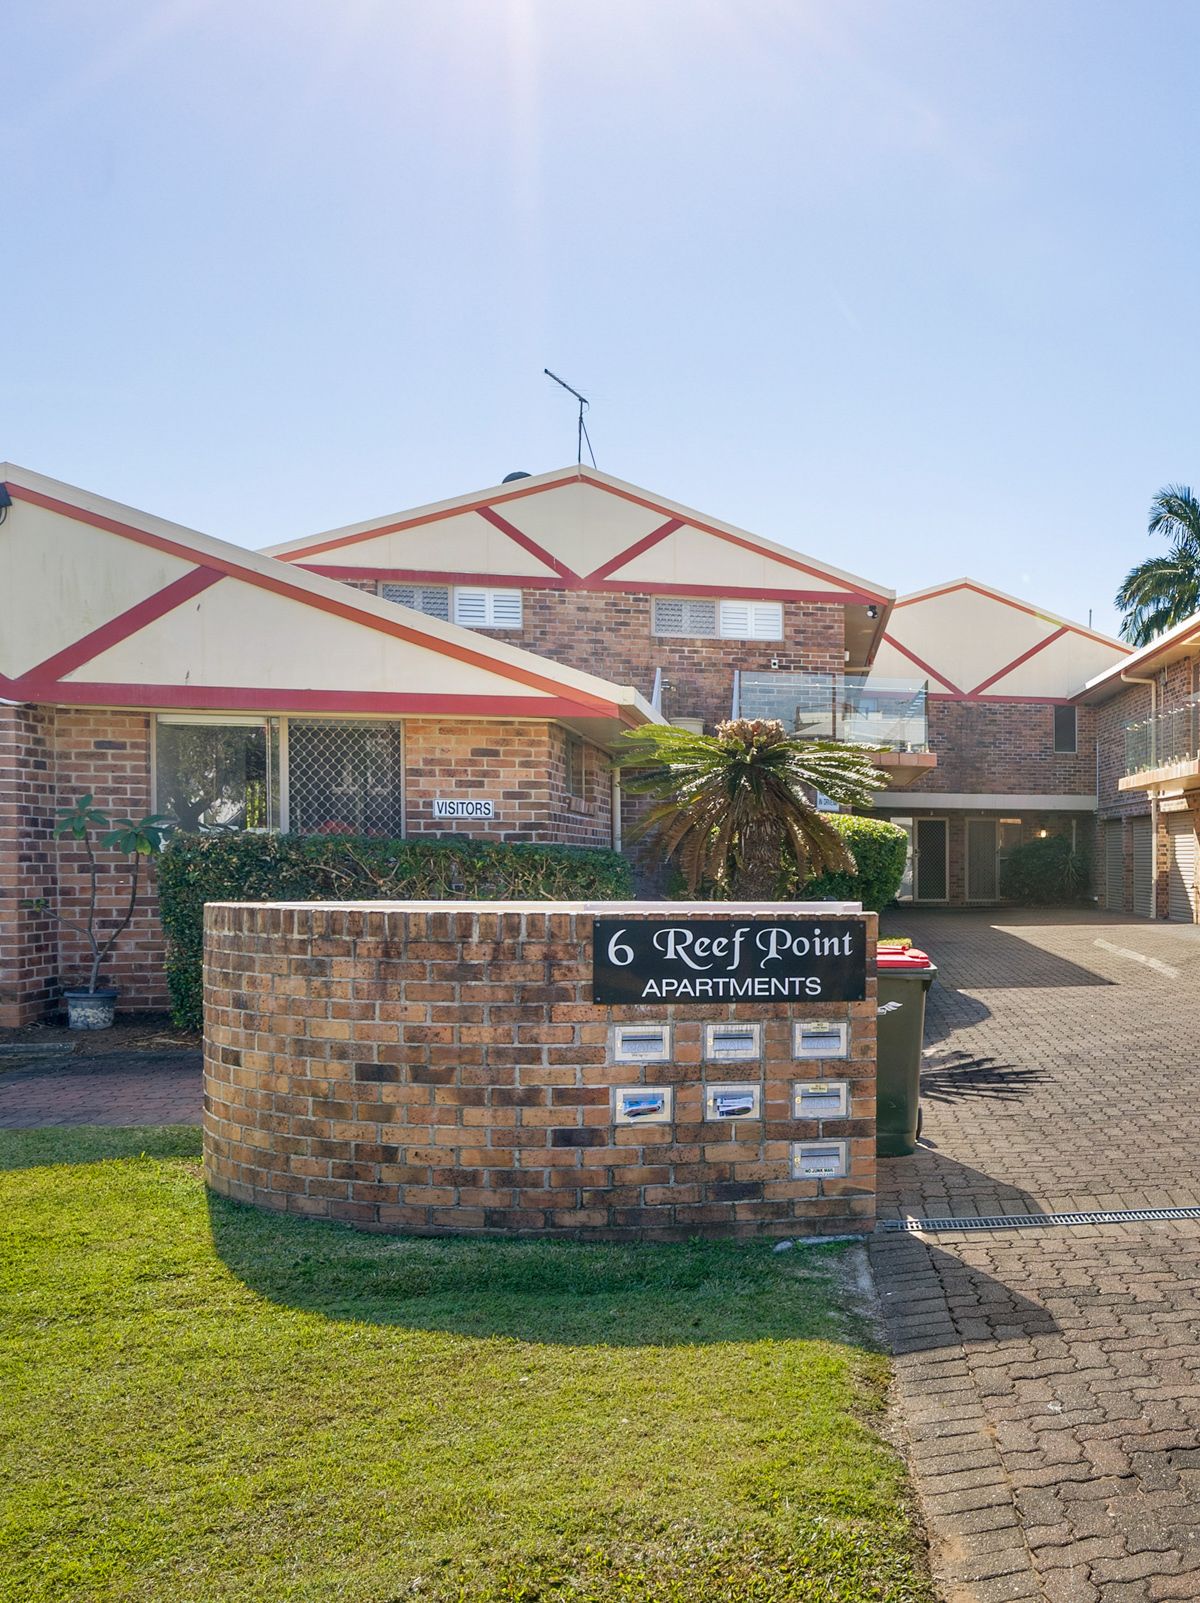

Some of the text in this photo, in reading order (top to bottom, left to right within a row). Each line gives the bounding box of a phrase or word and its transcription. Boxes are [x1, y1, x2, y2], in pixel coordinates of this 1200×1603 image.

[436, 801, 491, 816] VISITORS
[607, 927, 853, 971] 6 Reef Point
[641, 976, 822, 998] APARTMENTS
